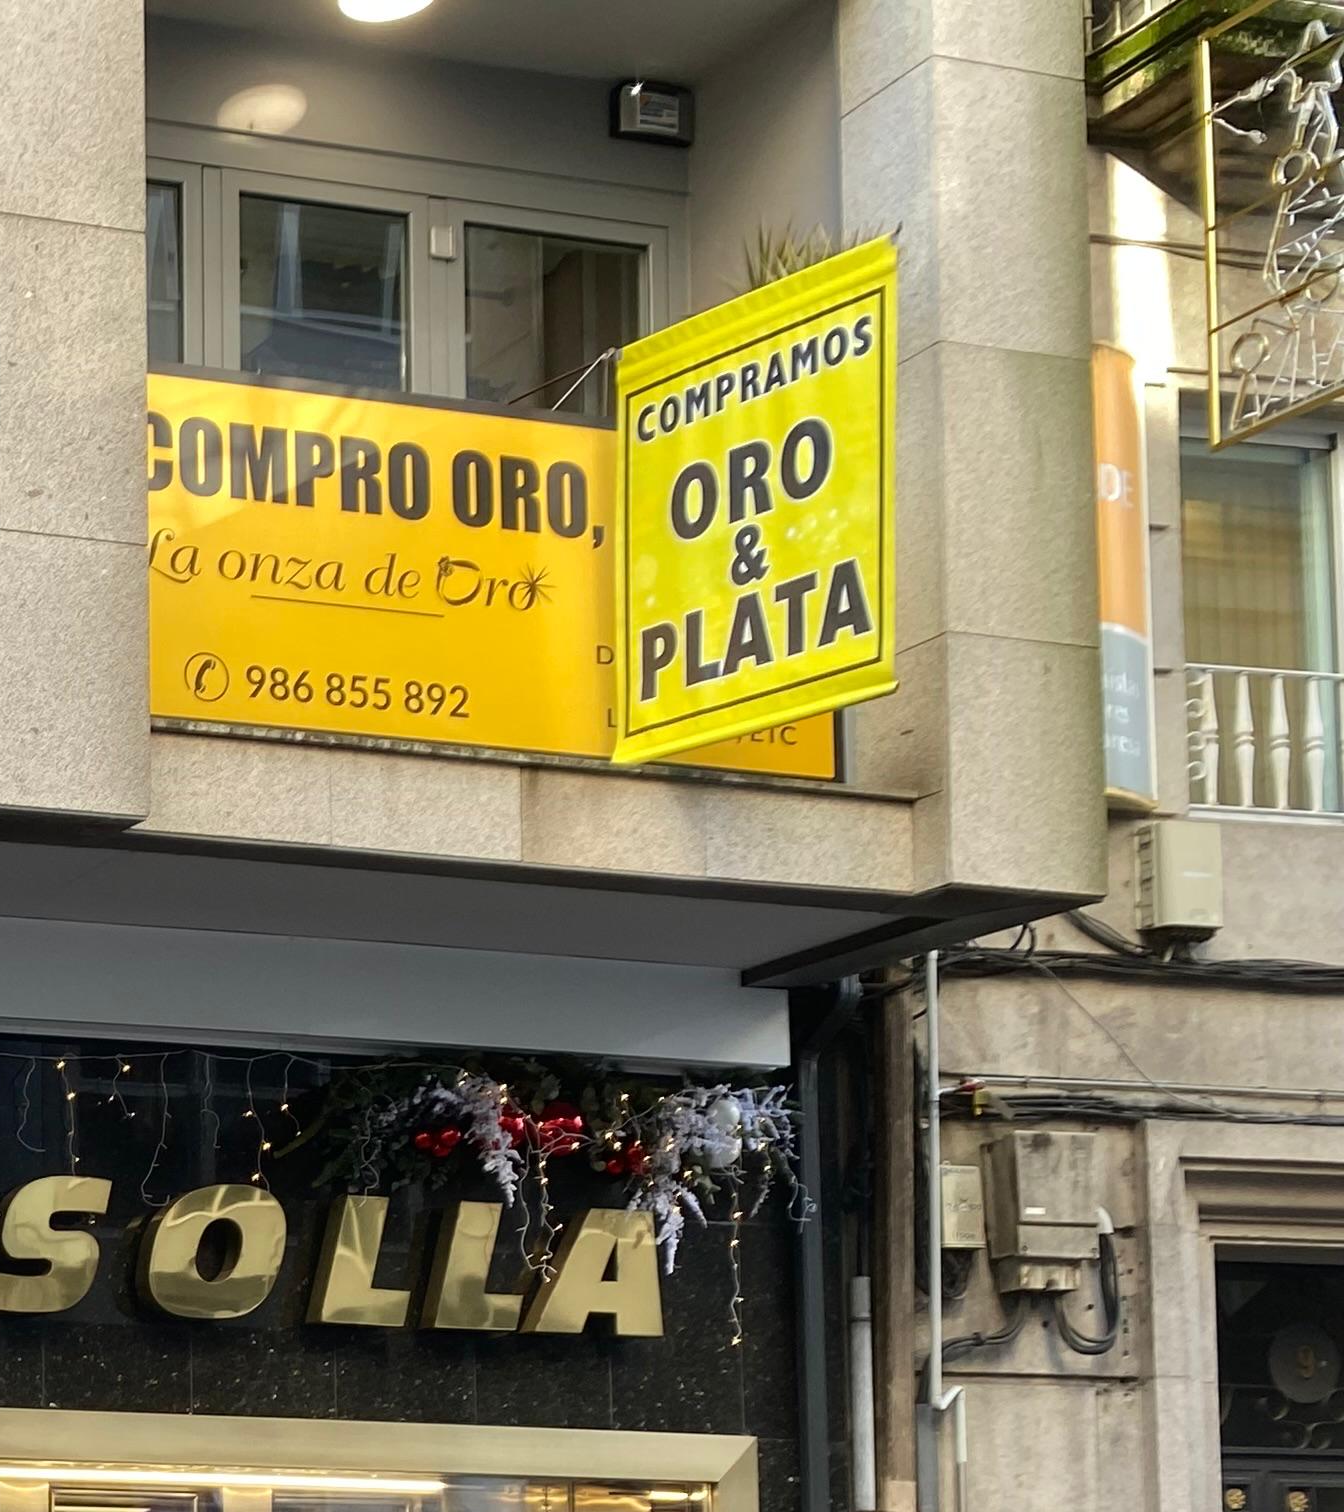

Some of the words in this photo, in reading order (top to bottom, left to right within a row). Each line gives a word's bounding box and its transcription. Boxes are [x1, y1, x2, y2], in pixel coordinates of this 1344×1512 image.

[637, 315, 874, 444] COMPRAMOS
[452, 449, 605, 550] ORO,
[670, 417, 832, 541] ORO
[149, 528, 202, 584] La
[217, 549, 346, 592] onza
[364, 553, 421, 599] de
[436, 556, 544, 612] Oro
[730, 525, 769, 586] &
[641, 558, 875, 702] PLATA
[245, 664, 314, 706] 986
[325, 672, 392, 712] 855
[404, 680, 470, 720] 892
